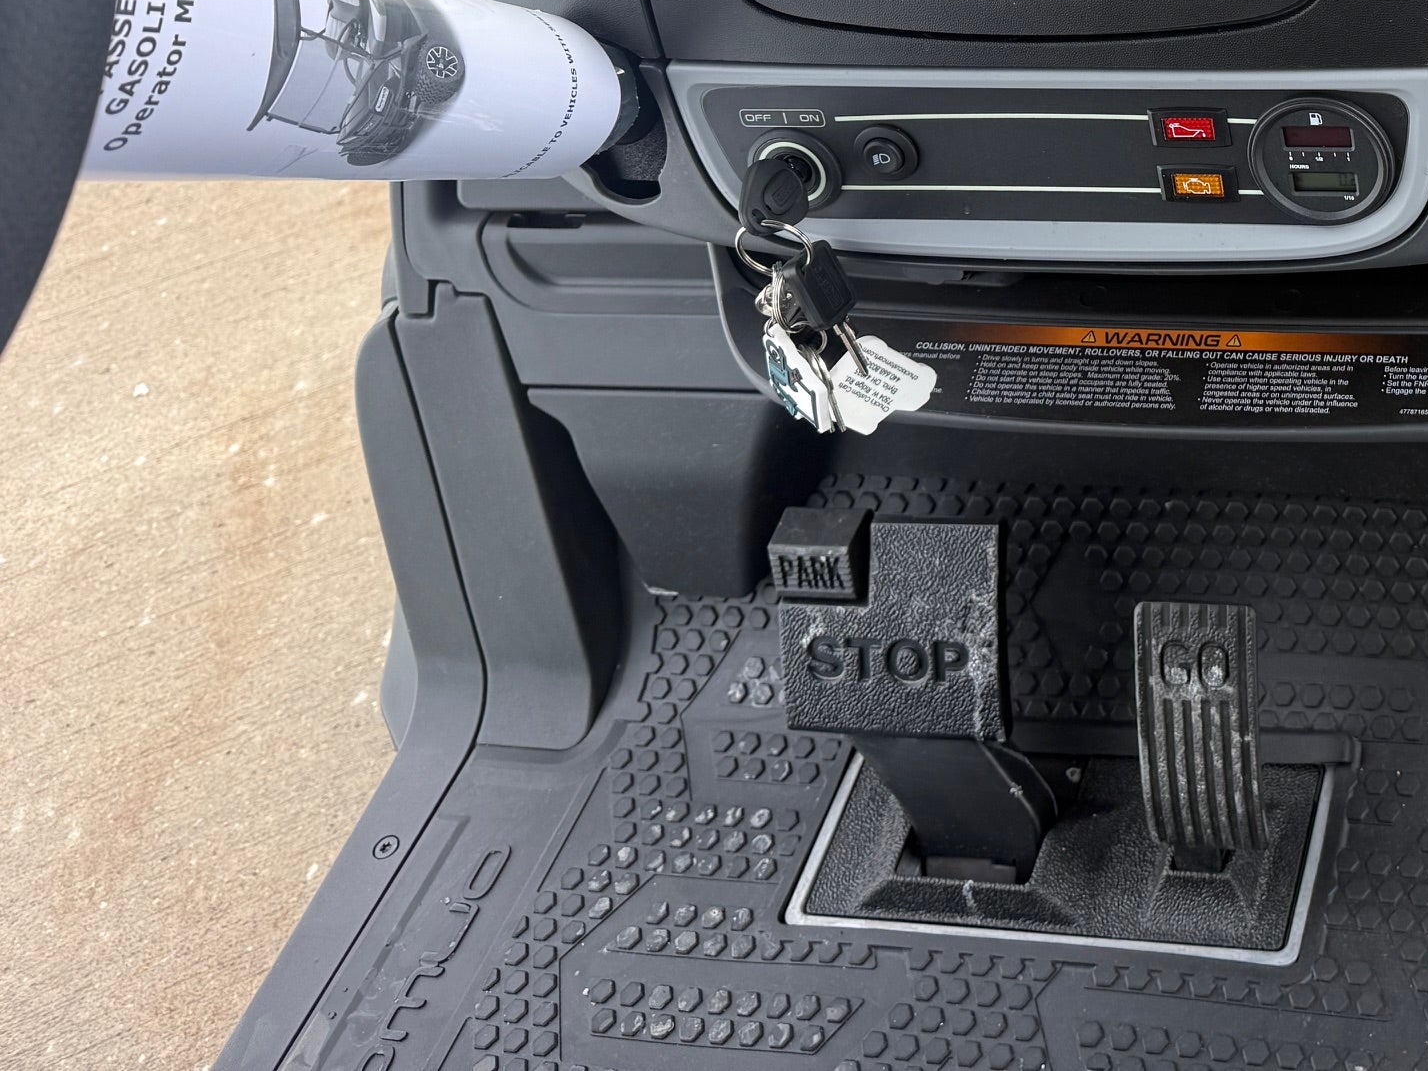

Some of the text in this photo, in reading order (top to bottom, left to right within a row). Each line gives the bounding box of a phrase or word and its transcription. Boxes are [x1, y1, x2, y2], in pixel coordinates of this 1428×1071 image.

[555, 34, 574, 64] WITH
[103, 34, 187, 152] Operator
[561, 67, 578, 128] VEHICLES
[745, 114, 820, 122] OFF ON
[549, 130, 563, 144] TO
[1104, 331, 1222, 347] WARNING
[913, 352, 938, 360] manual
[916, 341, 1409, 364] COLLISION, UNINTENDED MOVEMENT, ROLLOVERS, OR FALLING OUT CAN CAUSE SERIOUS INJURY OR DEATH
[1210, 362, 1238, 371] Operate
[1208, 369, 1246, 378] compliance
[1263, 371, 1298, 379] applicable
[1269, 377, 1302, 386] operating
[1246, 384, 1268, 393] higher
[1270, 385, 1291, 393] speed
[1292, 385, 1323, 394] vehicles,
[1385, 387, 1413, 396] Engage
[1202, 390, 1238, 399] congested
[1281, 392, 1322, 401] unimproved
[969, 395, 994, 403] Vehicle
[1013, 397, 1044, 406] operated
[1045, 398, 1054, 406] by
[1160, 402, 1177, 411] only.
[1224, 398, 1251, 406] operate
[1243, 405, 1263, 413] drugs
[777, 554, 846, 592] PARK
[805, 635, 972, 684] STOP
[1160, 640, 1230, 689] GO
